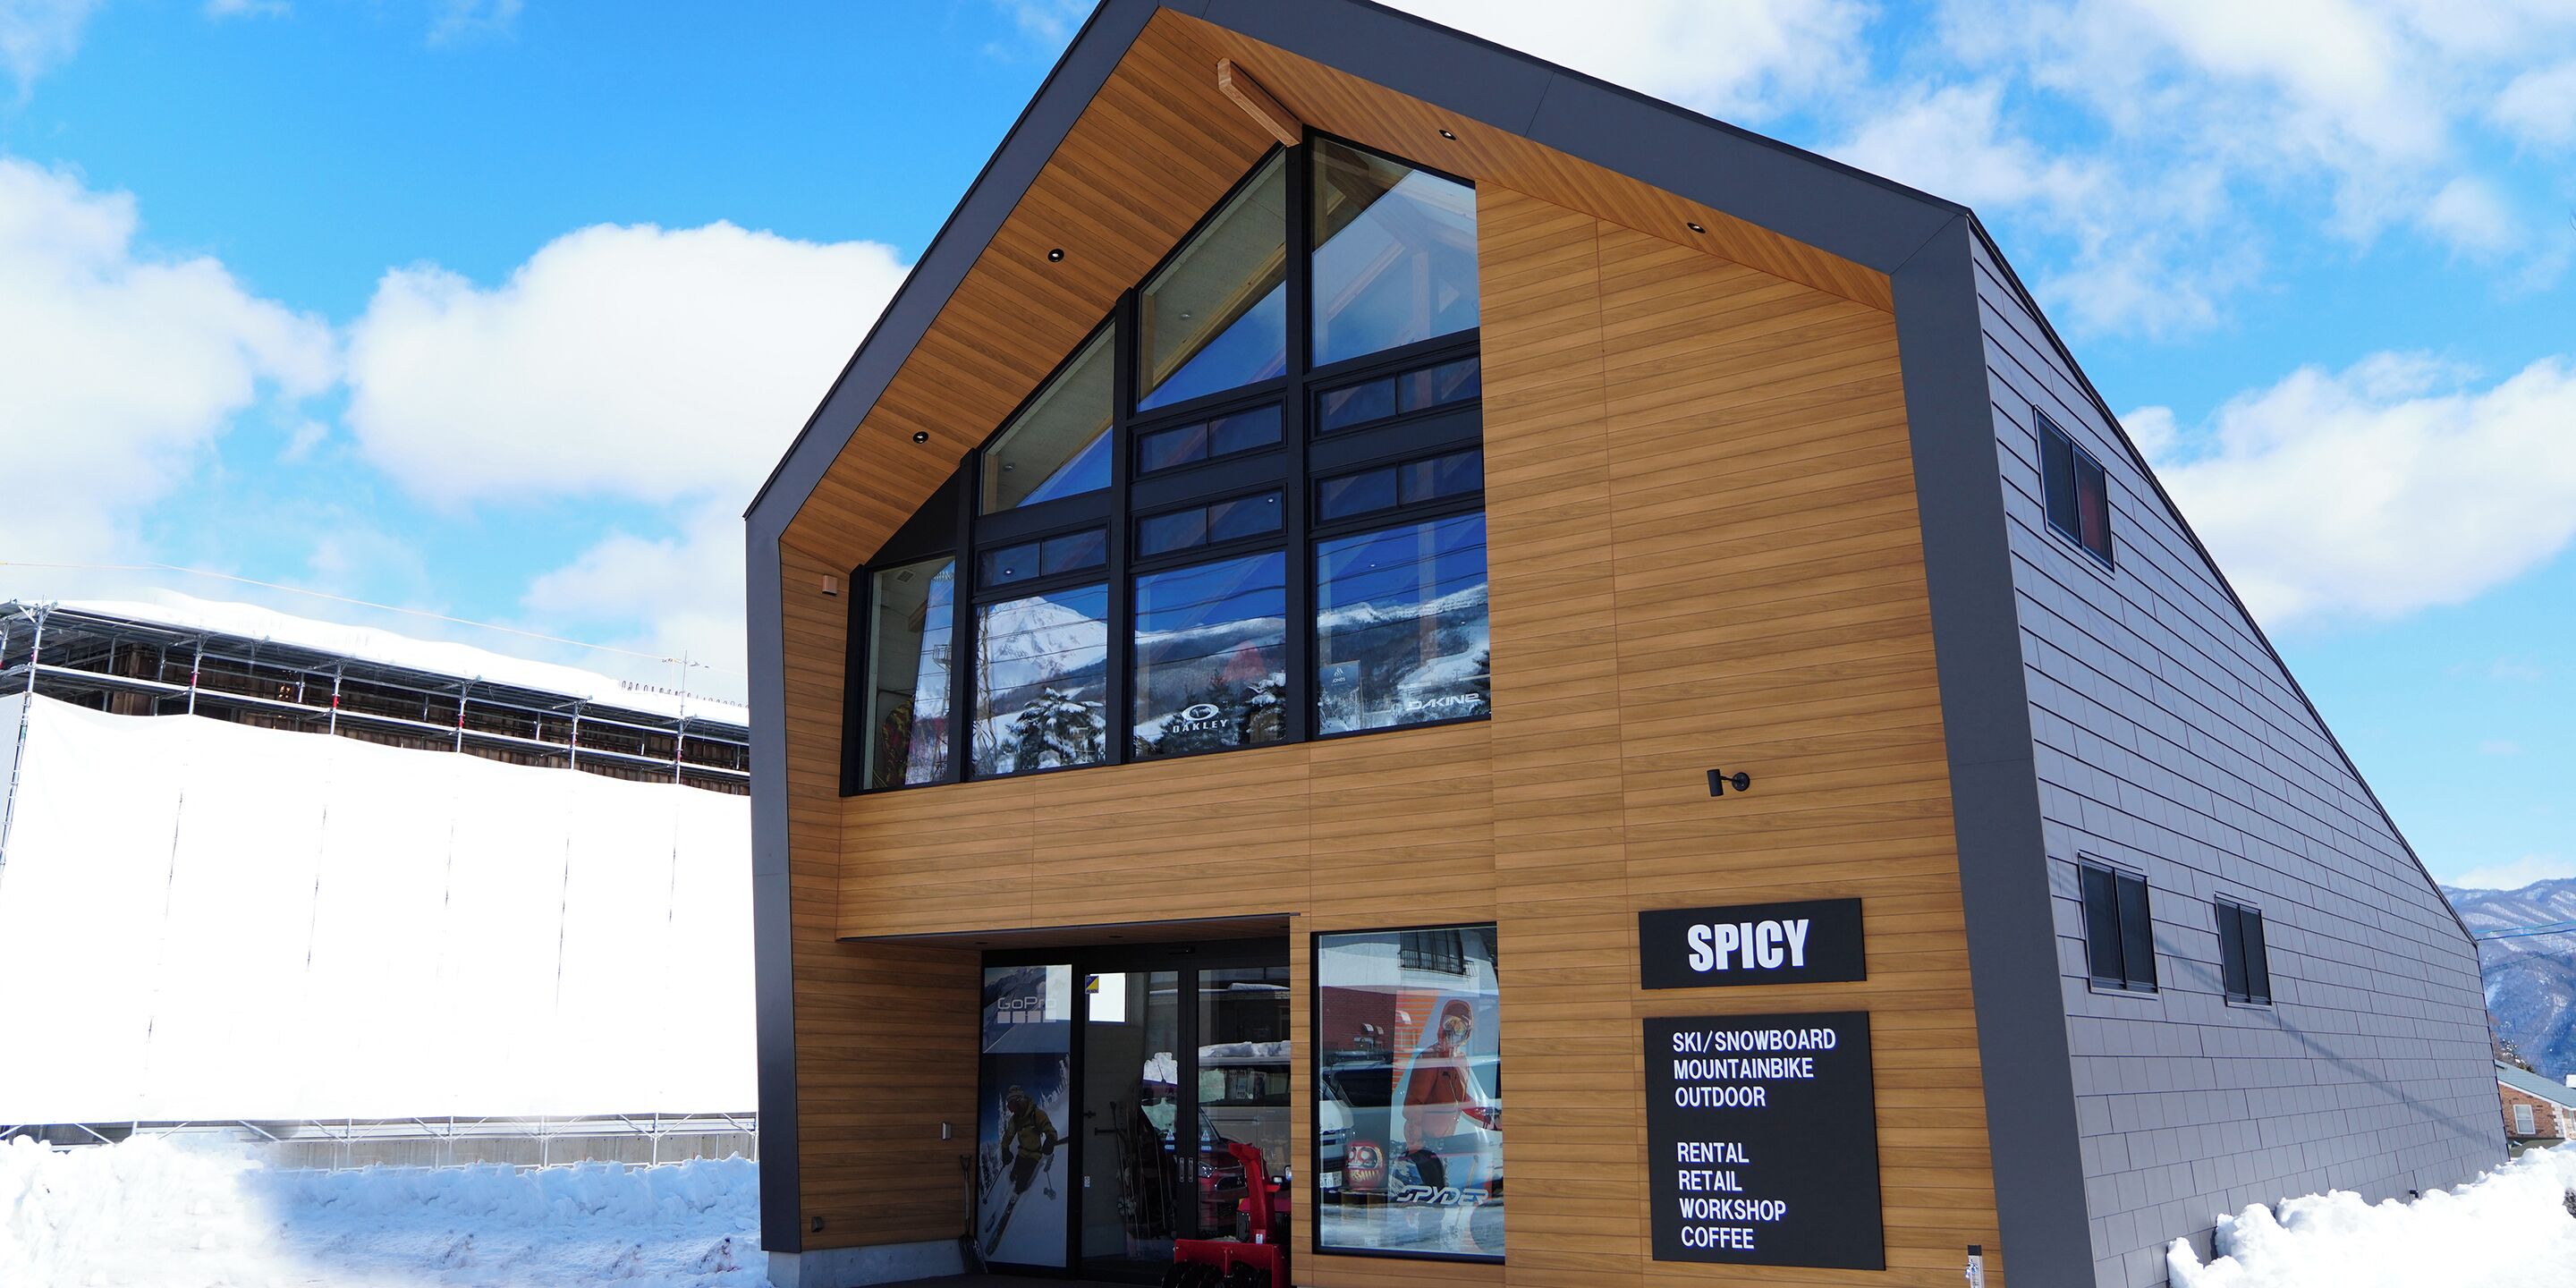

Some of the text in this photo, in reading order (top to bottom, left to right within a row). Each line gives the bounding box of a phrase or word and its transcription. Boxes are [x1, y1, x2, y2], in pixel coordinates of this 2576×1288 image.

[1405, 692, 1481, 711] DAKINE
[1173, 719, 1229, 733] OAKLEY
[1687, 919, 1809, 972] SPICY
[997, 996, 1057, 1010] GoPro
[1673, 1028, 1836, 1053] SKI/SNOWBOARD
[1674, 1056, 1814, 1080] MOUNTAINBIKE
[1674, 1086, 1767, 1107] OUTDOOR
[1677, 1141, 1750, 1164] RENTAL
[1678, 1169, 1743, 1191] RETAIL
[1397, 1184, 1488, 1206] SPYDER
[1679, 1198, 1786, 1222] WORKSHOP
[1681, 1225, 1755, 1250] COFFEE
